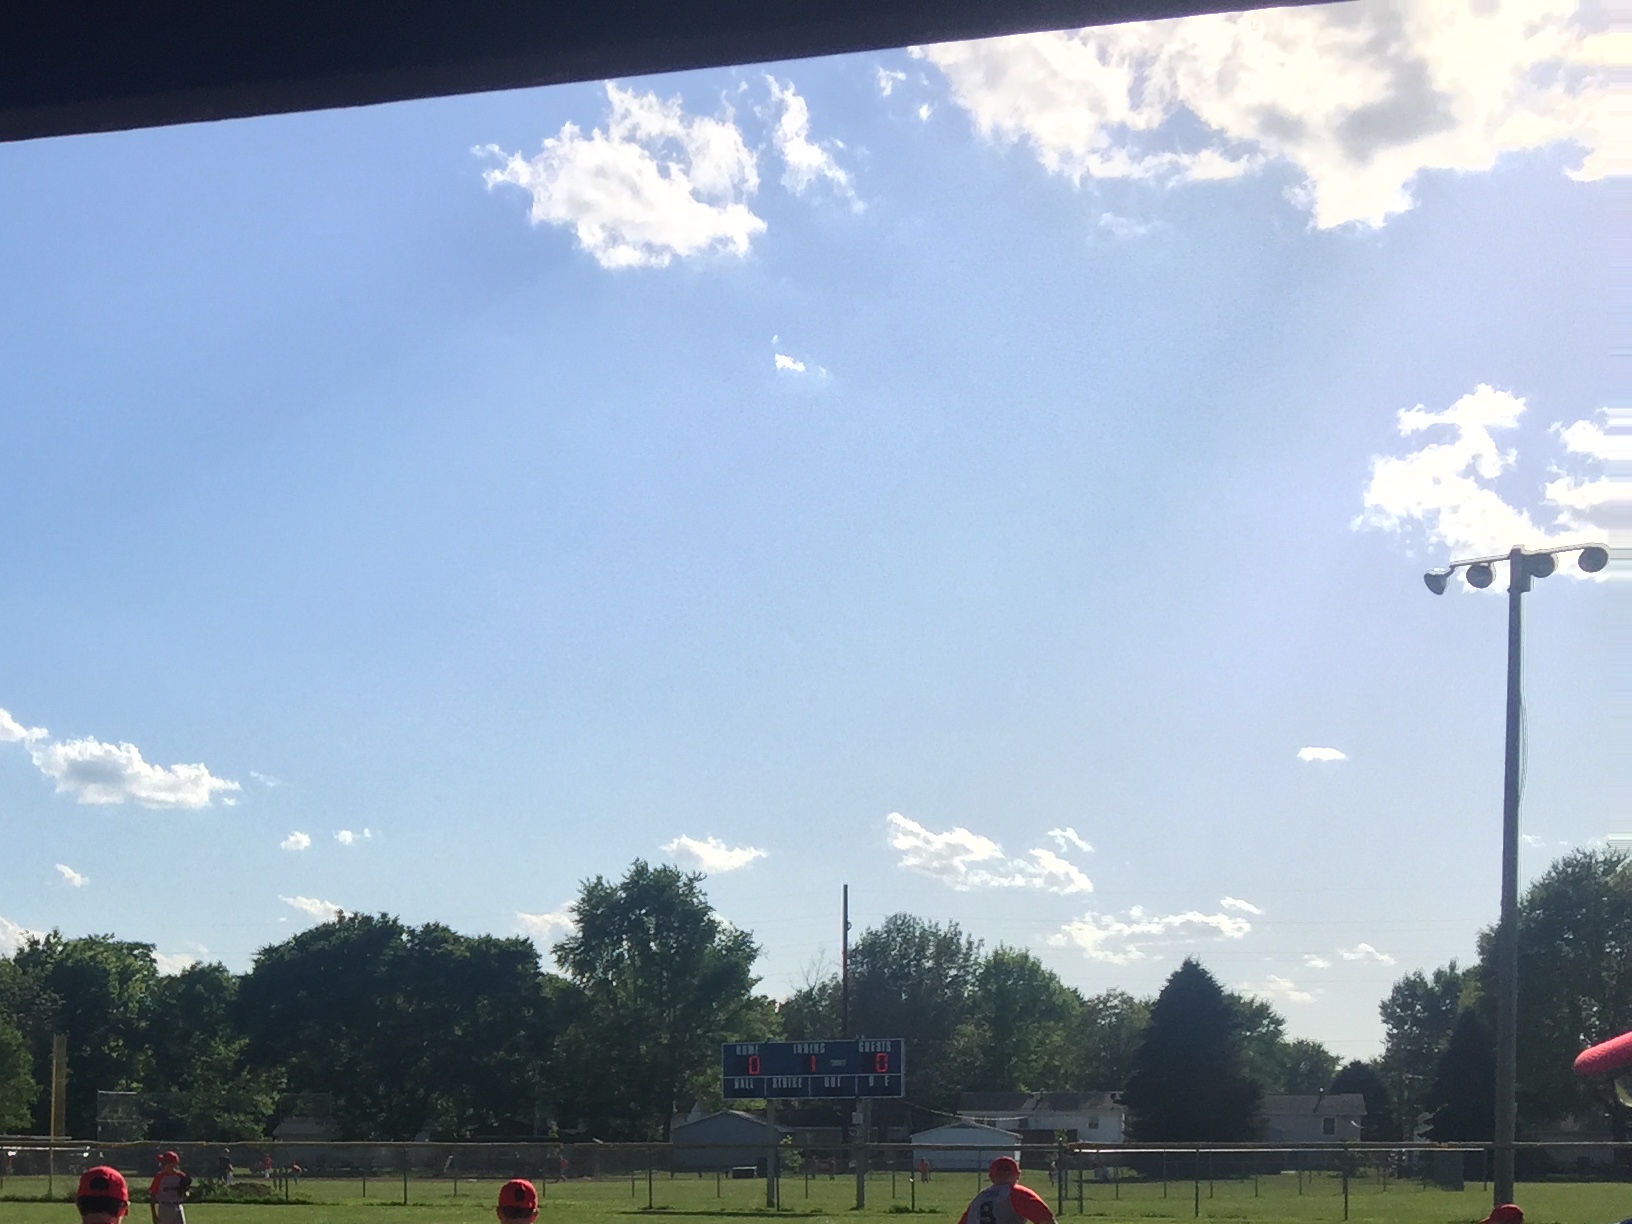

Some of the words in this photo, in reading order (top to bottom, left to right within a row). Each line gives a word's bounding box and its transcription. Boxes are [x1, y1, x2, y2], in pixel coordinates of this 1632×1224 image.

[858, 1041, 892, 1053] GUESTS
[748, 1055, 761, 1075] 0
[810, 1055, 817, 1073] 1
[874, 1052, 889, 1073] 0
[772, 1077, 803, 1089] STRIKE
[824, 1076, 841, 1088] OUT
